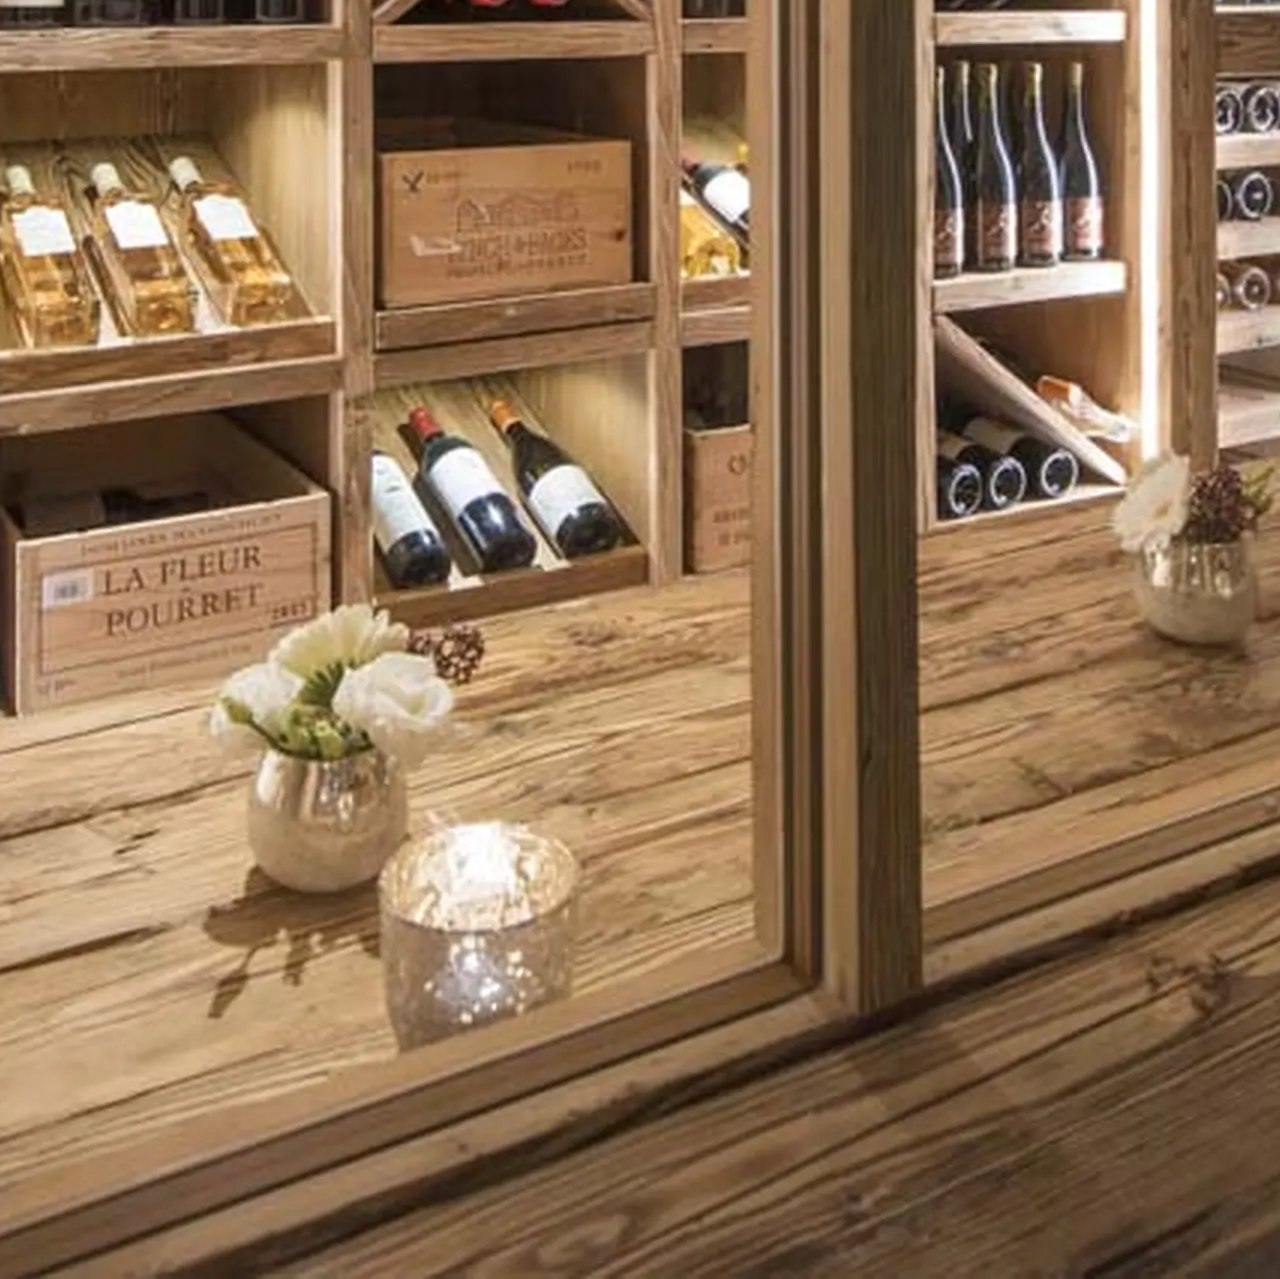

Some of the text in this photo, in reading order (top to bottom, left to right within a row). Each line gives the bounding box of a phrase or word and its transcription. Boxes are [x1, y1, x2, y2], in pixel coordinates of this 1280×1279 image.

[103, 545, 262, 595] LA FLEUR
[106, 583, 264, 637] POURRET
